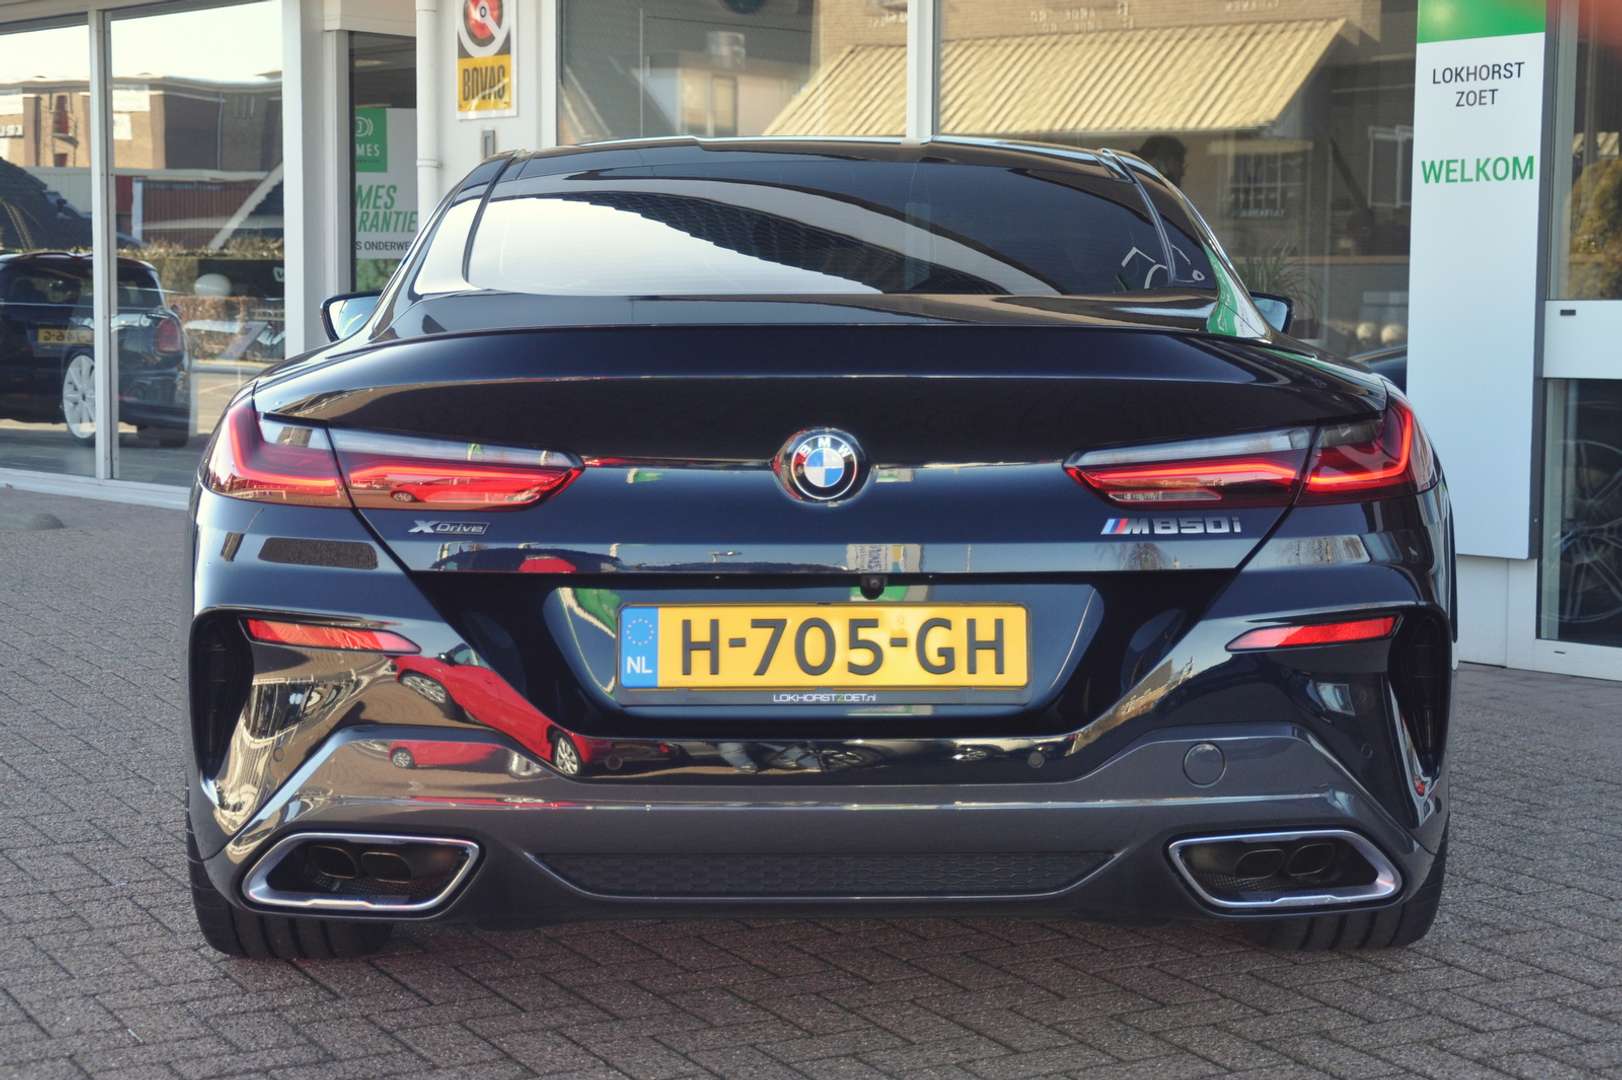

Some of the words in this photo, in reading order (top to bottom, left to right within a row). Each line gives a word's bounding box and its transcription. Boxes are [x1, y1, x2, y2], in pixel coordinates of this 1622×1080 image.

[1432, 61, 1525, 84] LOKHORST
[1455, 88, 1499, 107] ZOET
[1420, 155, 1535, 184] WELKOM
[798, 436, 852, 458] BMW
[1116, 516, 1242, 535] M850i
[681, 617, 1005, 676] H-705-GH
[626, 655, 653, 675] NL
